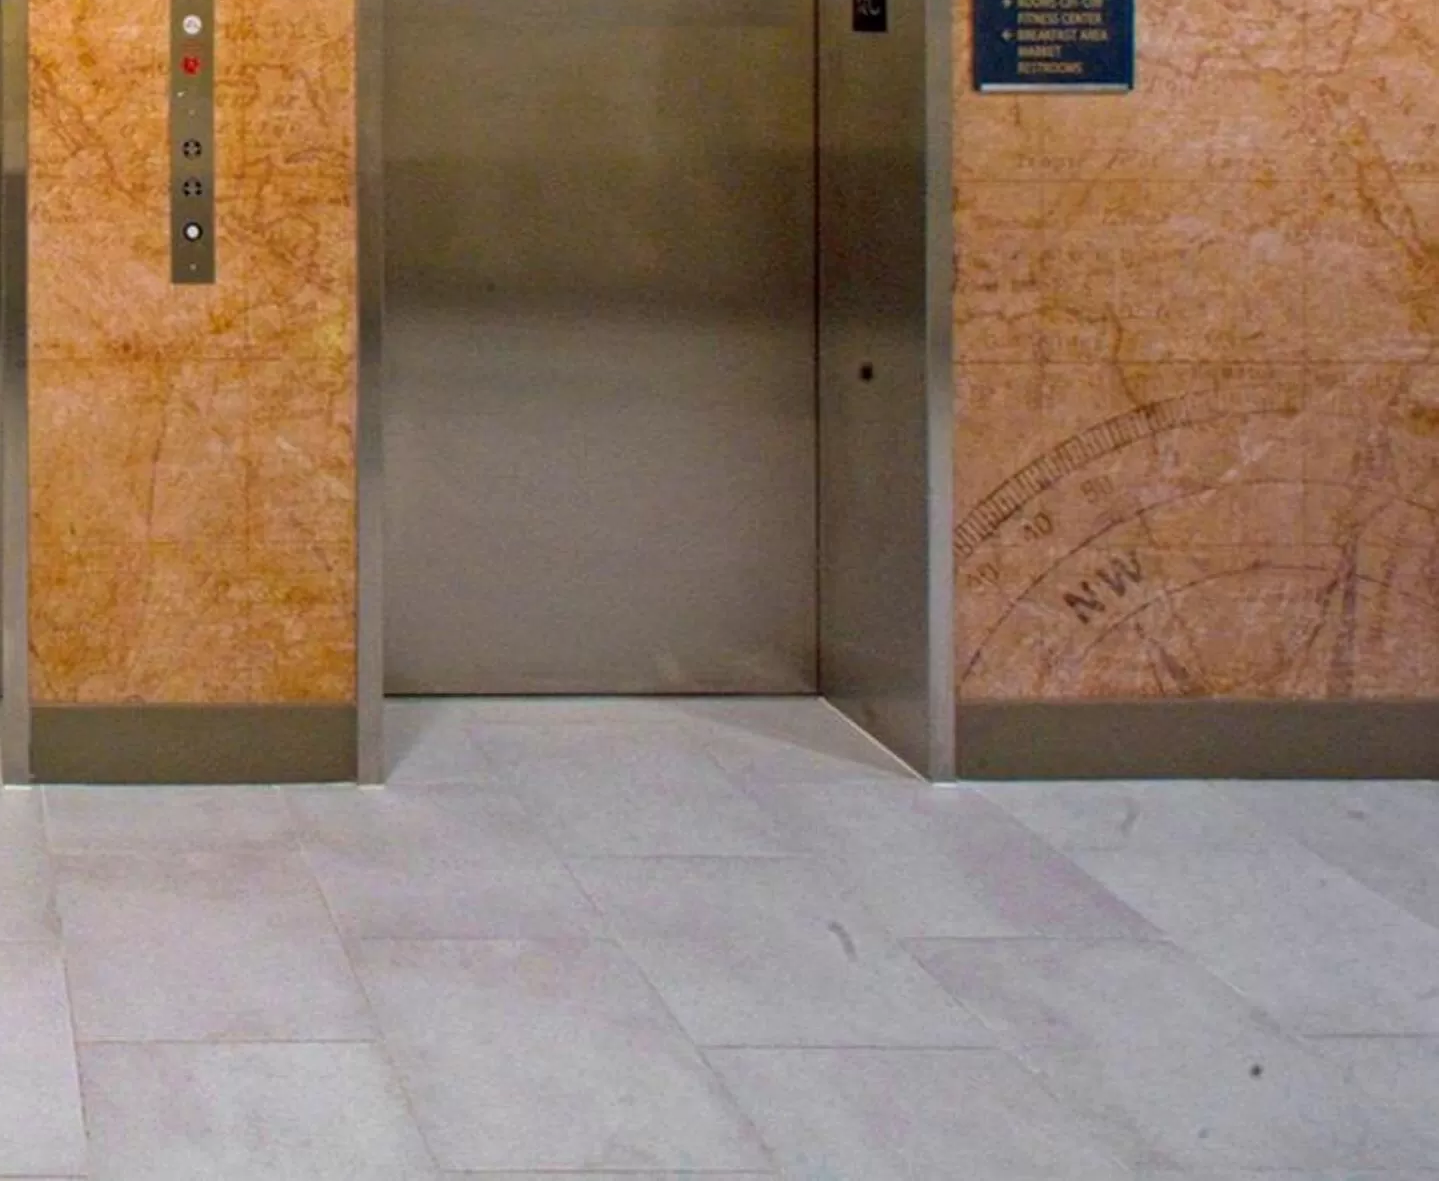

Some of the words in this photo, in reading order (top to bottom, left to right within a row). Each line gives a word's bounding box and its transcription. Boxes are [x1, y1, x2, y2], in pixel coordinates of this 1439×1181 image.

[1016, 13, 1060, 25] FITNESS
[1062, 13, 1102, 25] CENTER
[1016, 29, 1078, 41] BREAKFAST
[1079, 29, 1109, 41] AREA
[1016, 45, 1062, 58] MARKET
[1016, 61, 1084, 75] RESTROOMS
